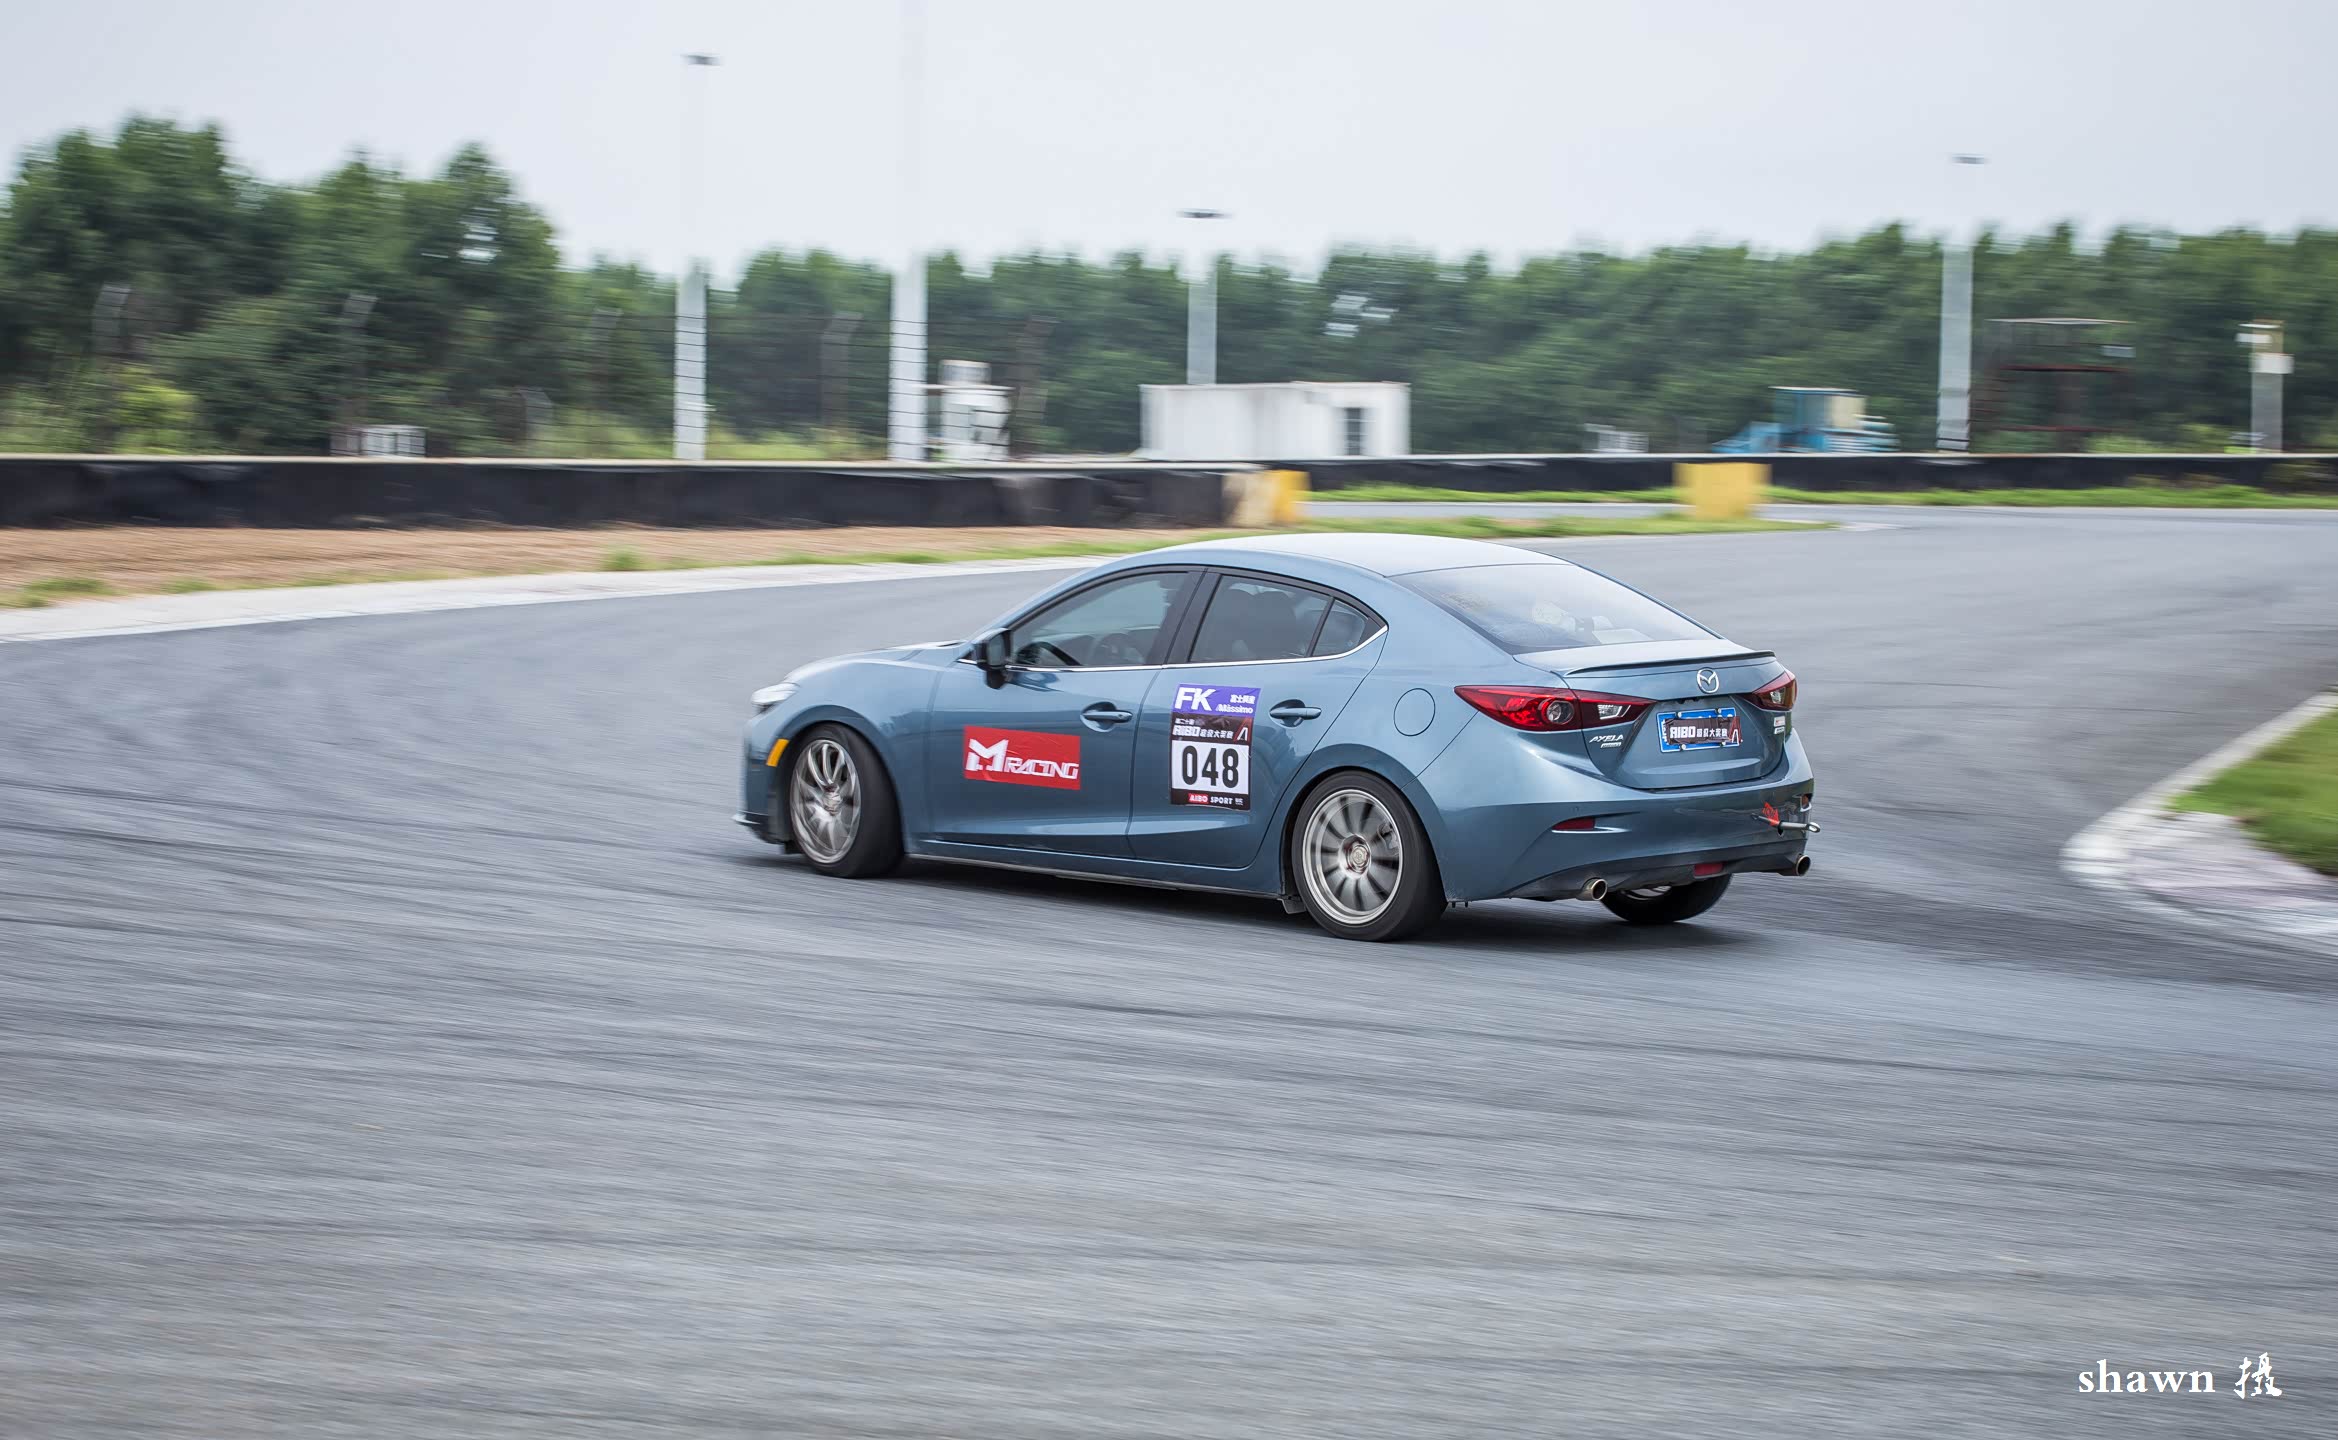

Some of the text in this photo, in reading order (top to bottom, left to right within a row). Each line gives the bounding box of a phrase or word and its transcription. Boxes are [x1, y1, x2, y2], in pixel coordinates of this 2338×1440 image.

[1174, 686, 1216, 711] FK
[1589, 734, 1624, 743] AXELA
[1182, 745, 1239, 789] 048
[1210, 796, 1233, 805] SPORT
